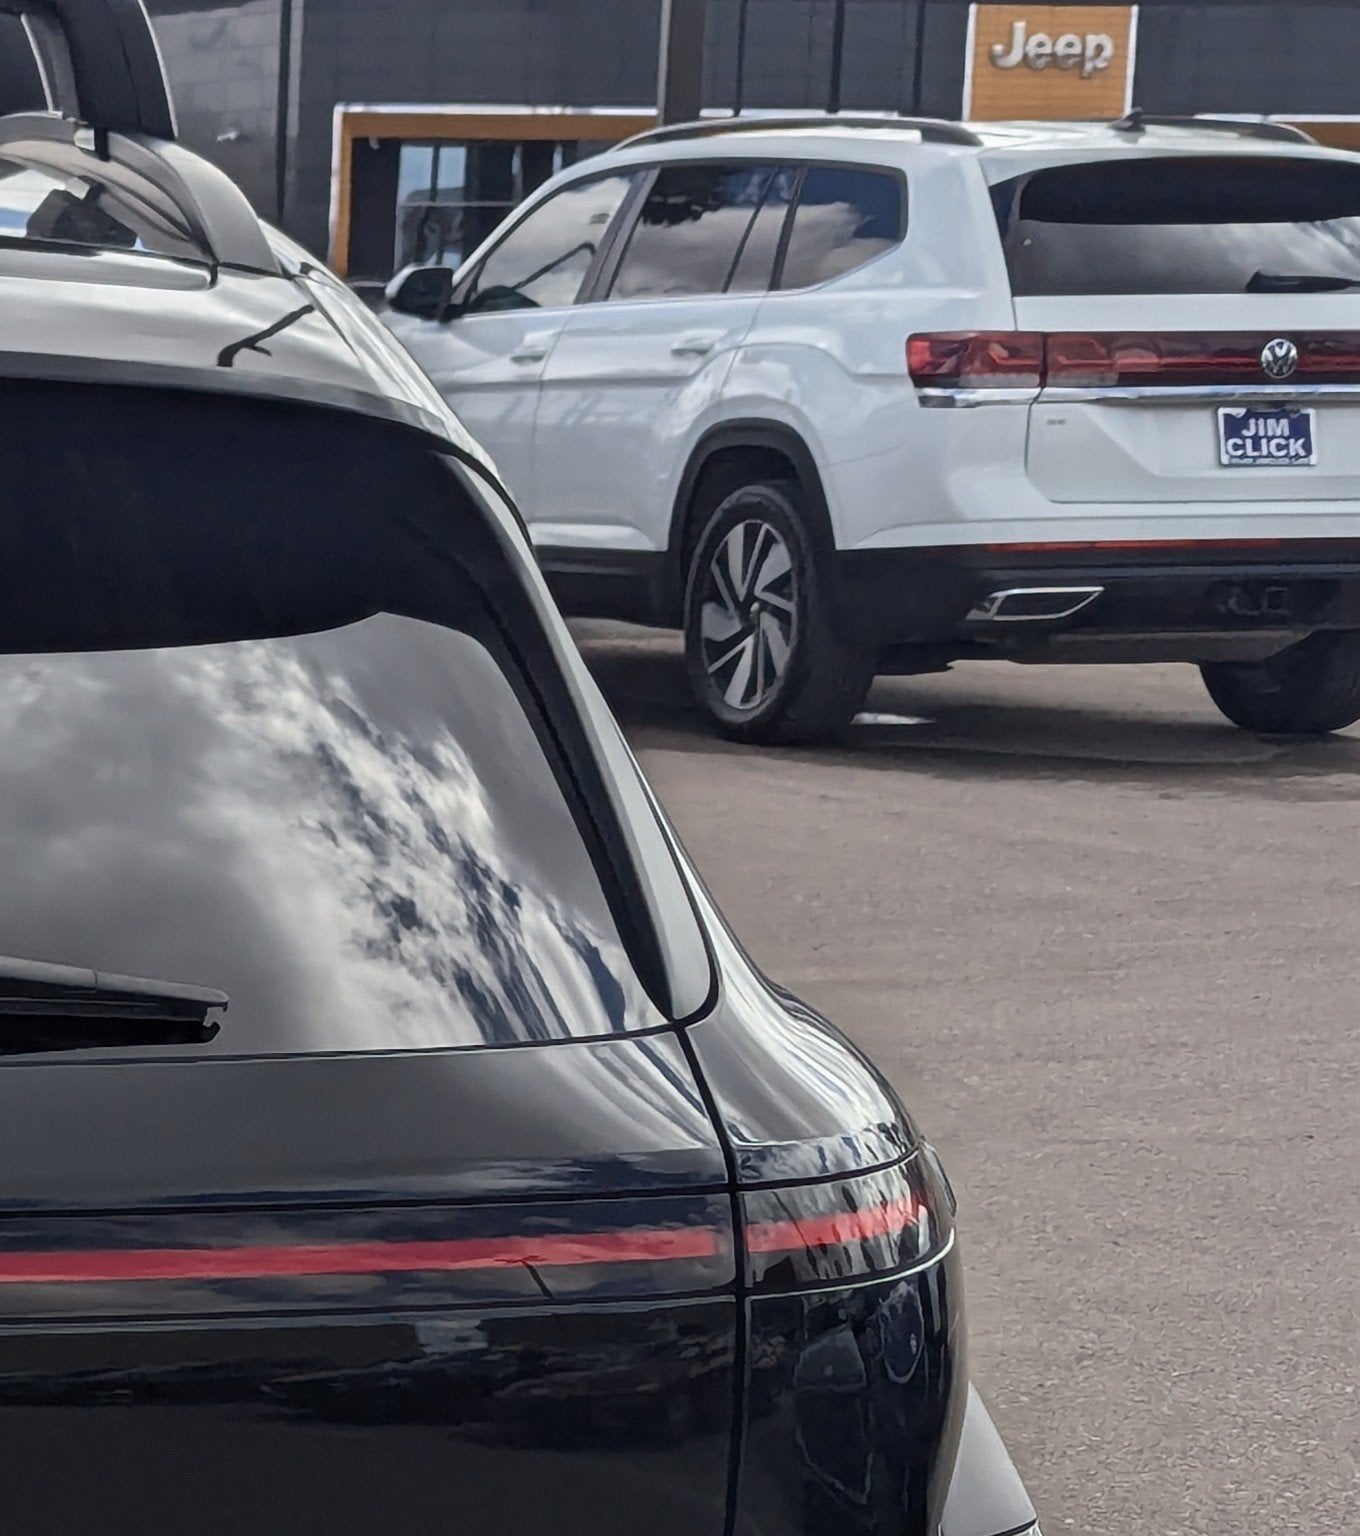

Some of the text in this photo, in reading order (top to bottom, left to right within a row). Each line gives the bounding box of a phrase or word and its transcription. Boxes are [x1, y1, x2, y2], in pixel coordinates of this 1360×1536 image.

[992, 20, 1114, 79] Jeep
[1241, 418, 1290, 437] JIM
[1226, 437, 1306, 457] CLICK
